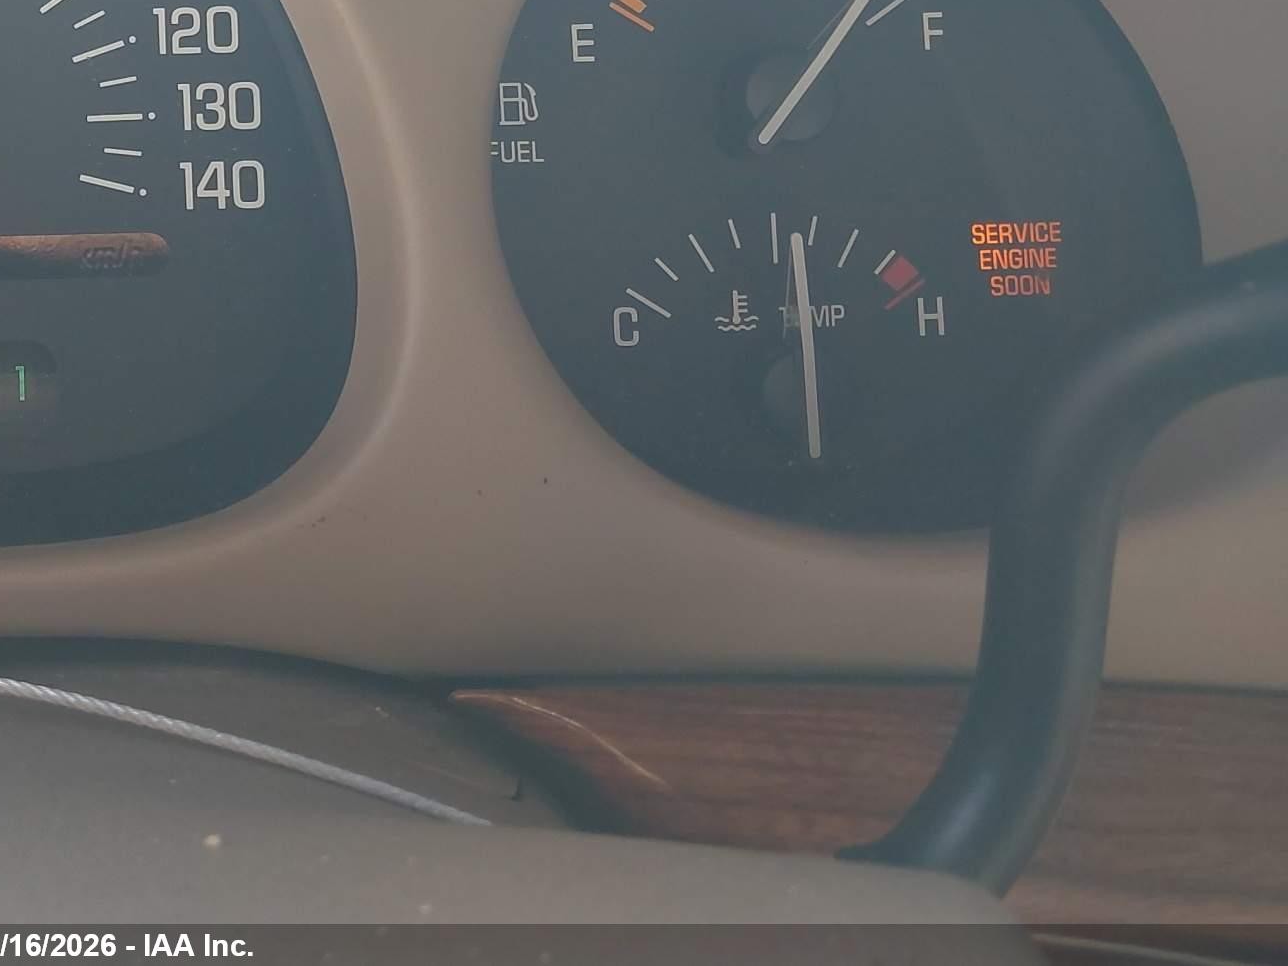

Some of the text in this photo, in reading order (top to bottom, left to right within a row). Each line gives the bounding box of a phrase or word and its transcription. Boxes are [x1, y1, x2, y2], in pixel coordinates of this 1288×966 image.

[153, 6, 238, 54] 120
[572, 24, 595, 61] E
[923, 12, 943, 50] F
[178, 82, 260, 130] 130
[180, 161, 264, 209] 140
[972, 221, 1062, 245] SERVICE
[979, 247, 1057, 270] ENGINE
[990, 275, 1050, 296] SOON
[613, 307, 640, 347] C
[778, 304, 845, 328] TMP
[918, 297, 944, 336] H
[15, 365, 26, 402] 1
